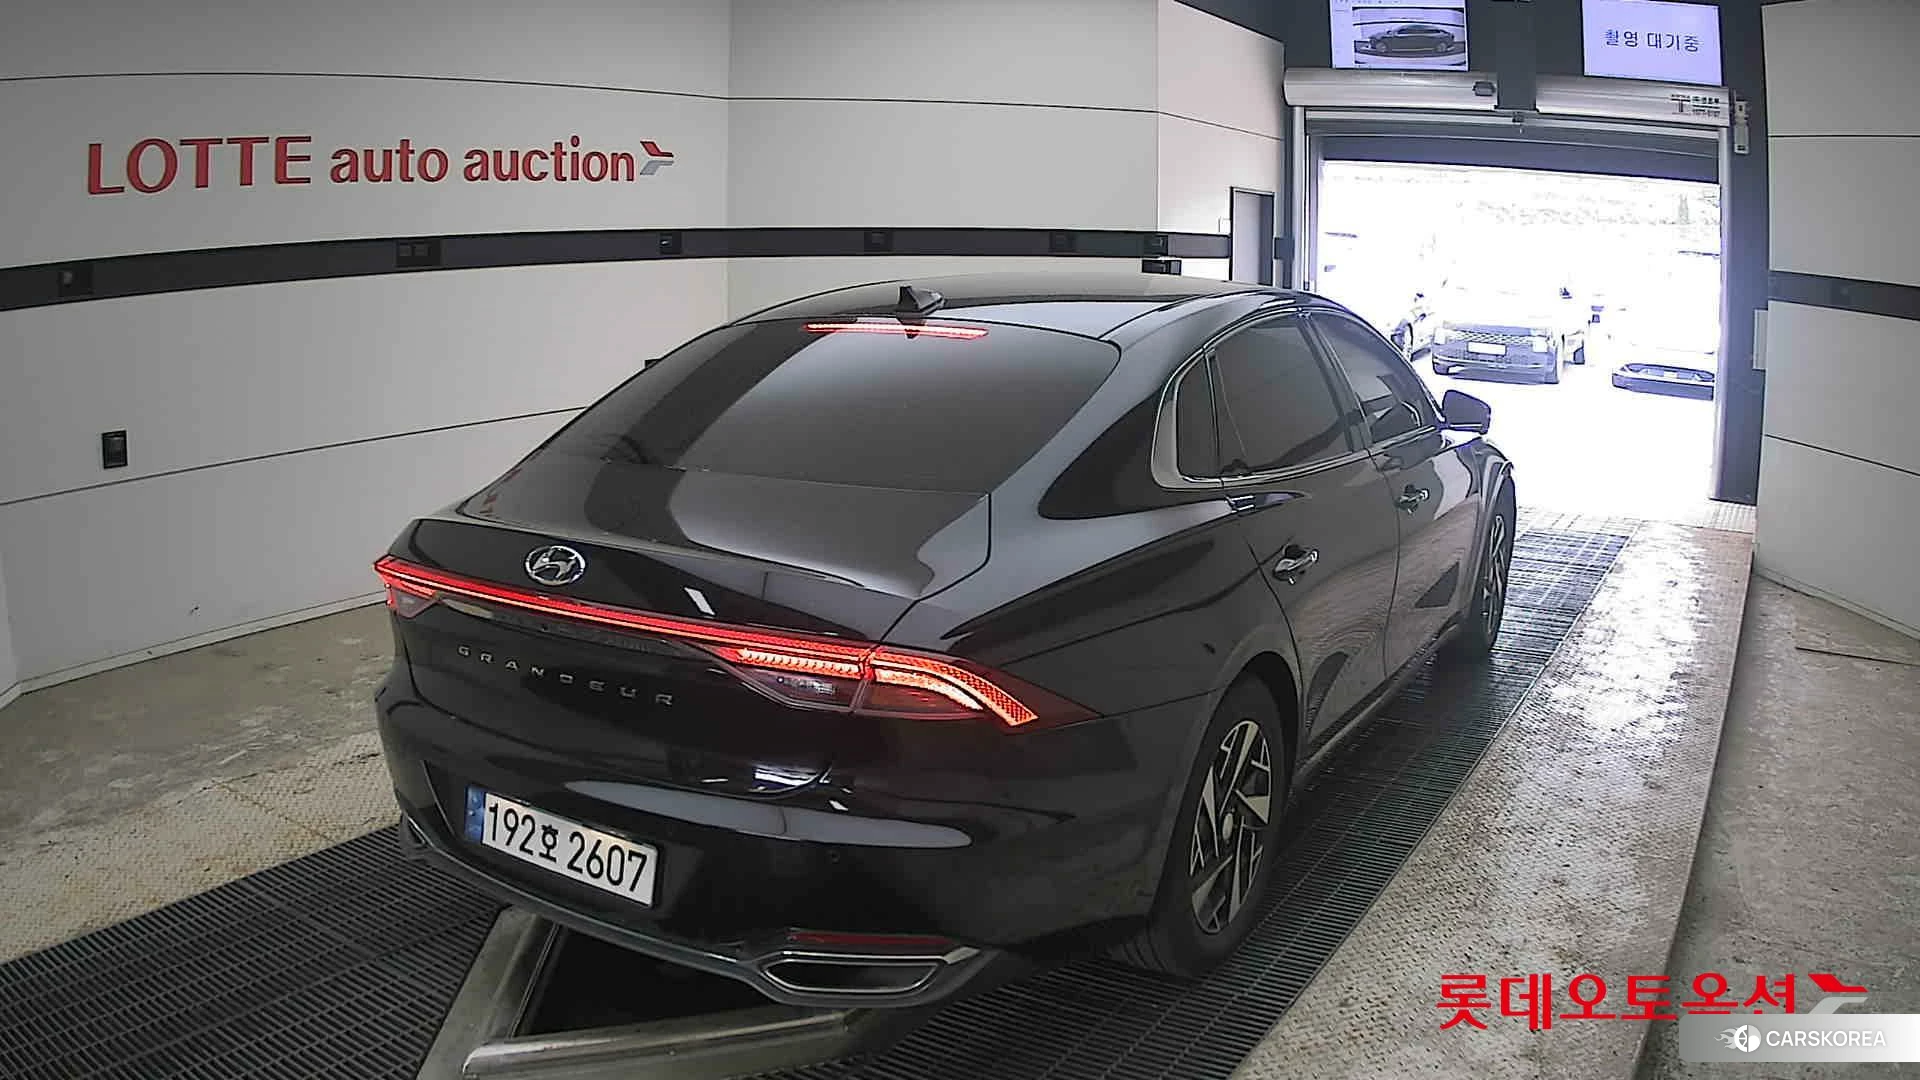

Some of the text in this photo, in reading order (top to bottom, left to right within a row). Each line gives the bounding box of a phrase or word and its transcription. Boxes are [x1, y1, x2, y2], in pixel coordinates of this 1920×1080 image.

[1647, 31, 1700, 52] 대기중
[87, 135, 635, 195] LOTTE auto auction
[457, 646, 673, 706] GRANDEUR
[489, 803, 648, 893] 192호 2607
